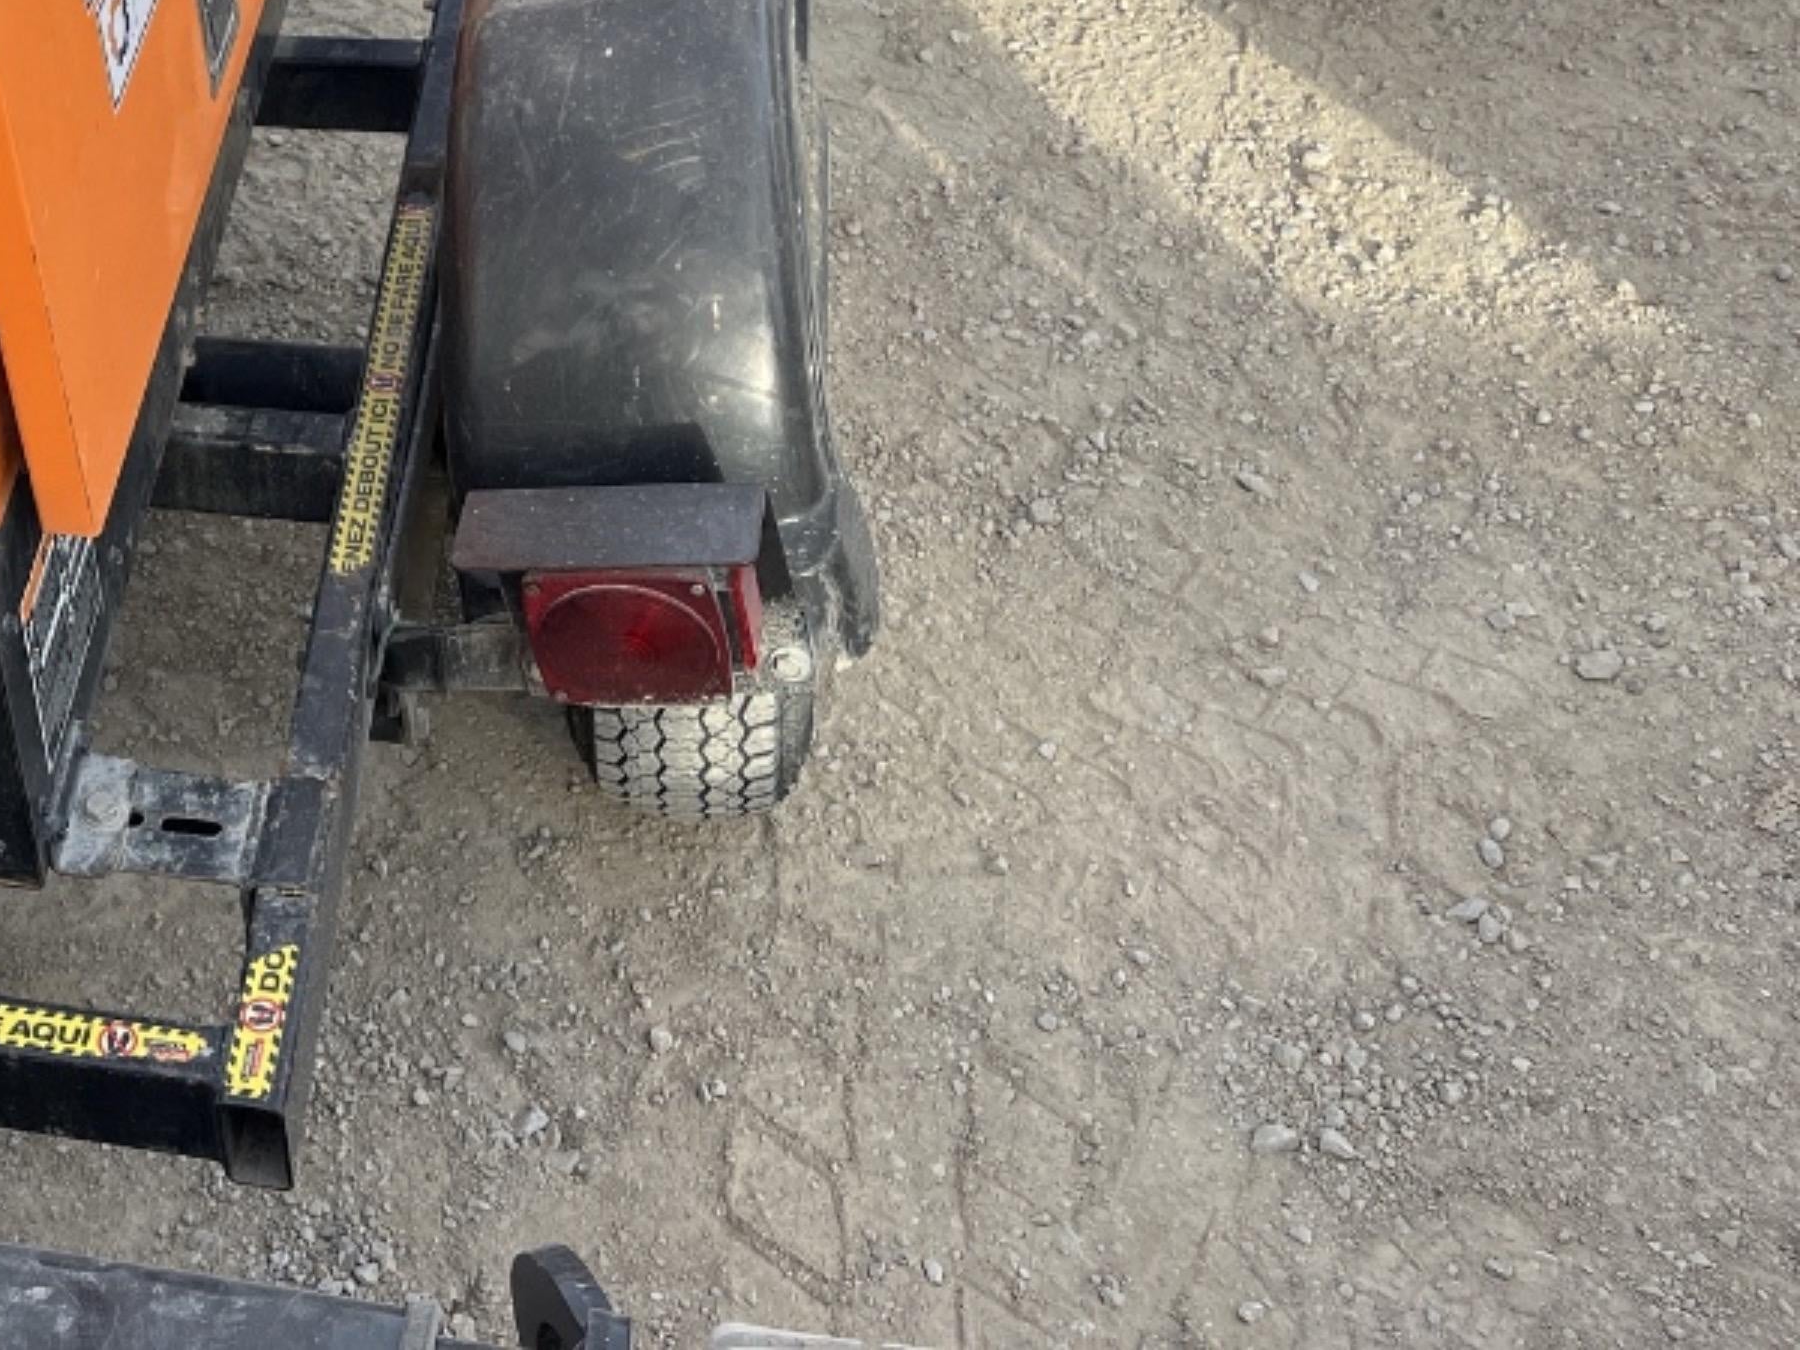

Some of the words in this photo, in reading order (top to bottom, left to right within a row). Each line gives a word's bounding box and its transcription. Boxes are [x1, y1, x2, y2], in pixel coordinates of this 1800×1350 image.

[353, 427, 386, 511] DEBOUT
[372, 397, 392, 424] ICI
[8, 1023, 92, 1047] AQUI
